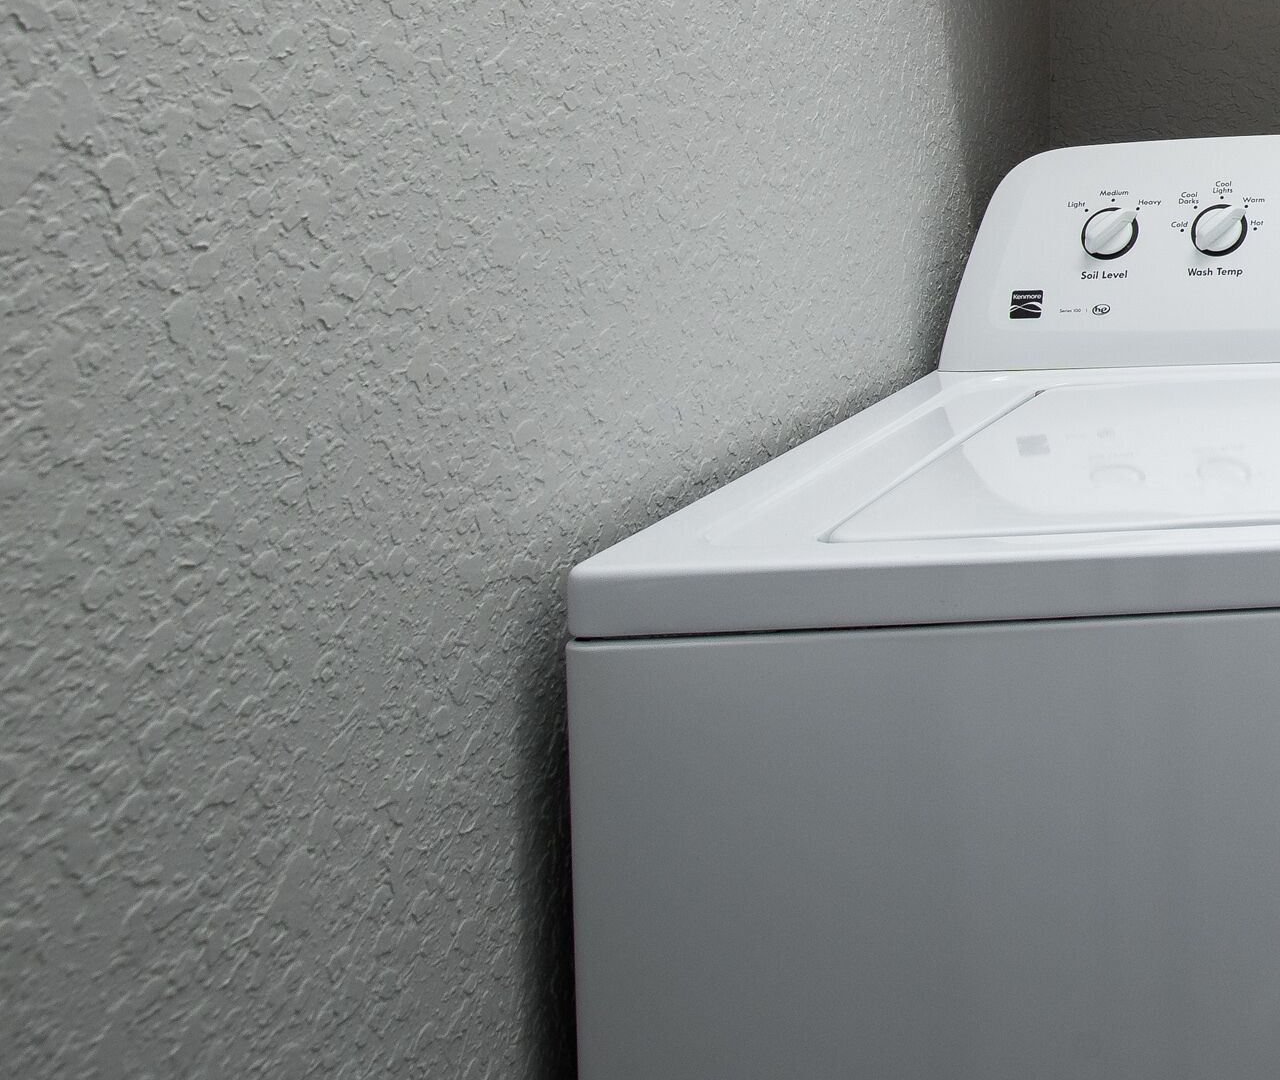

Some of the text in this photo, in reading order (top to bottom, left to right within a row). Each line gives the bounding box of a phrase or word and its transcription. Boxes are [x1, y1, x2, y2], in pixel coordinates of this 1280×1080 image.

[1138, 199, 1162, 207] Heavy
[1250, 219, 1264, 227] Hot
[1080, 270, 1128, 280] Soil Level
[1187, 267, 1243, 277] Wash Temp
